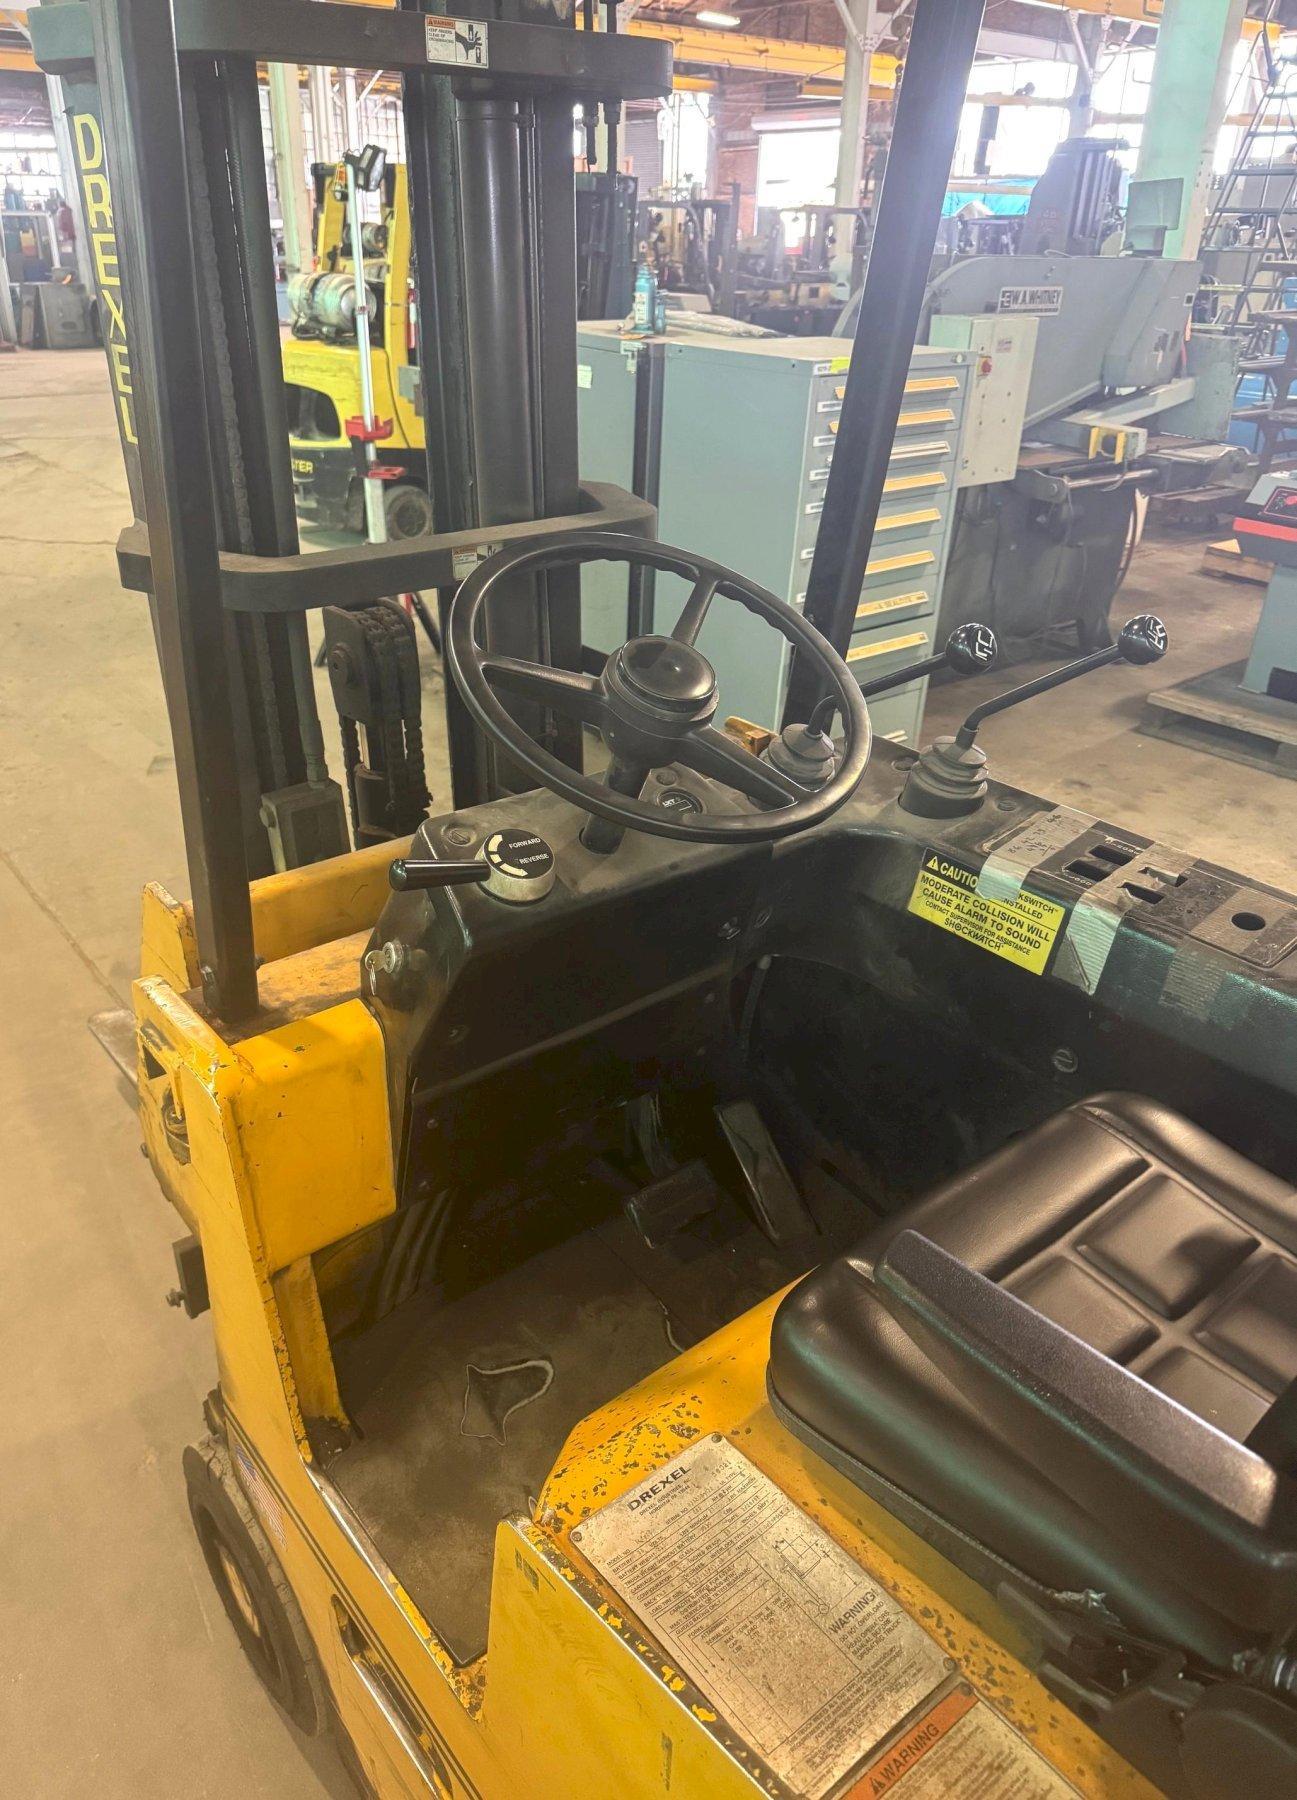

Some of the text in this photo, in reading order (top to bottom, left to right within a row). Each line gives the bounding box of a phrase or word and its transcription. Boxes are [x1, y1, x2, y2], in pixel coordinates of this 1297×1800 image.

[73, 113, 138, 445] DREXEL
[509, 837, 541, 849] FORWARD
[519, 853, 549, 864] REVERSE
[939, 861, 978, 888] CAUTIO
[920, 875, 1051, 942] MODERATE COLLISION WILL
[922, 887, 1041, 949] CAUSE ALARM TO SOUND
[925, 900, 1031, 955] CONTACT SUPERVISOR FOR ASSISTANCE
[1002, 896, 1042, 919] NSTALLED
[625, 1466, 692, 1511] DREXEL
[606, 1553, 623, 1567] MODEL
[827, 1587, 879, 1634] WARNING!
[883, 1722, 941, 1780] WARNING
